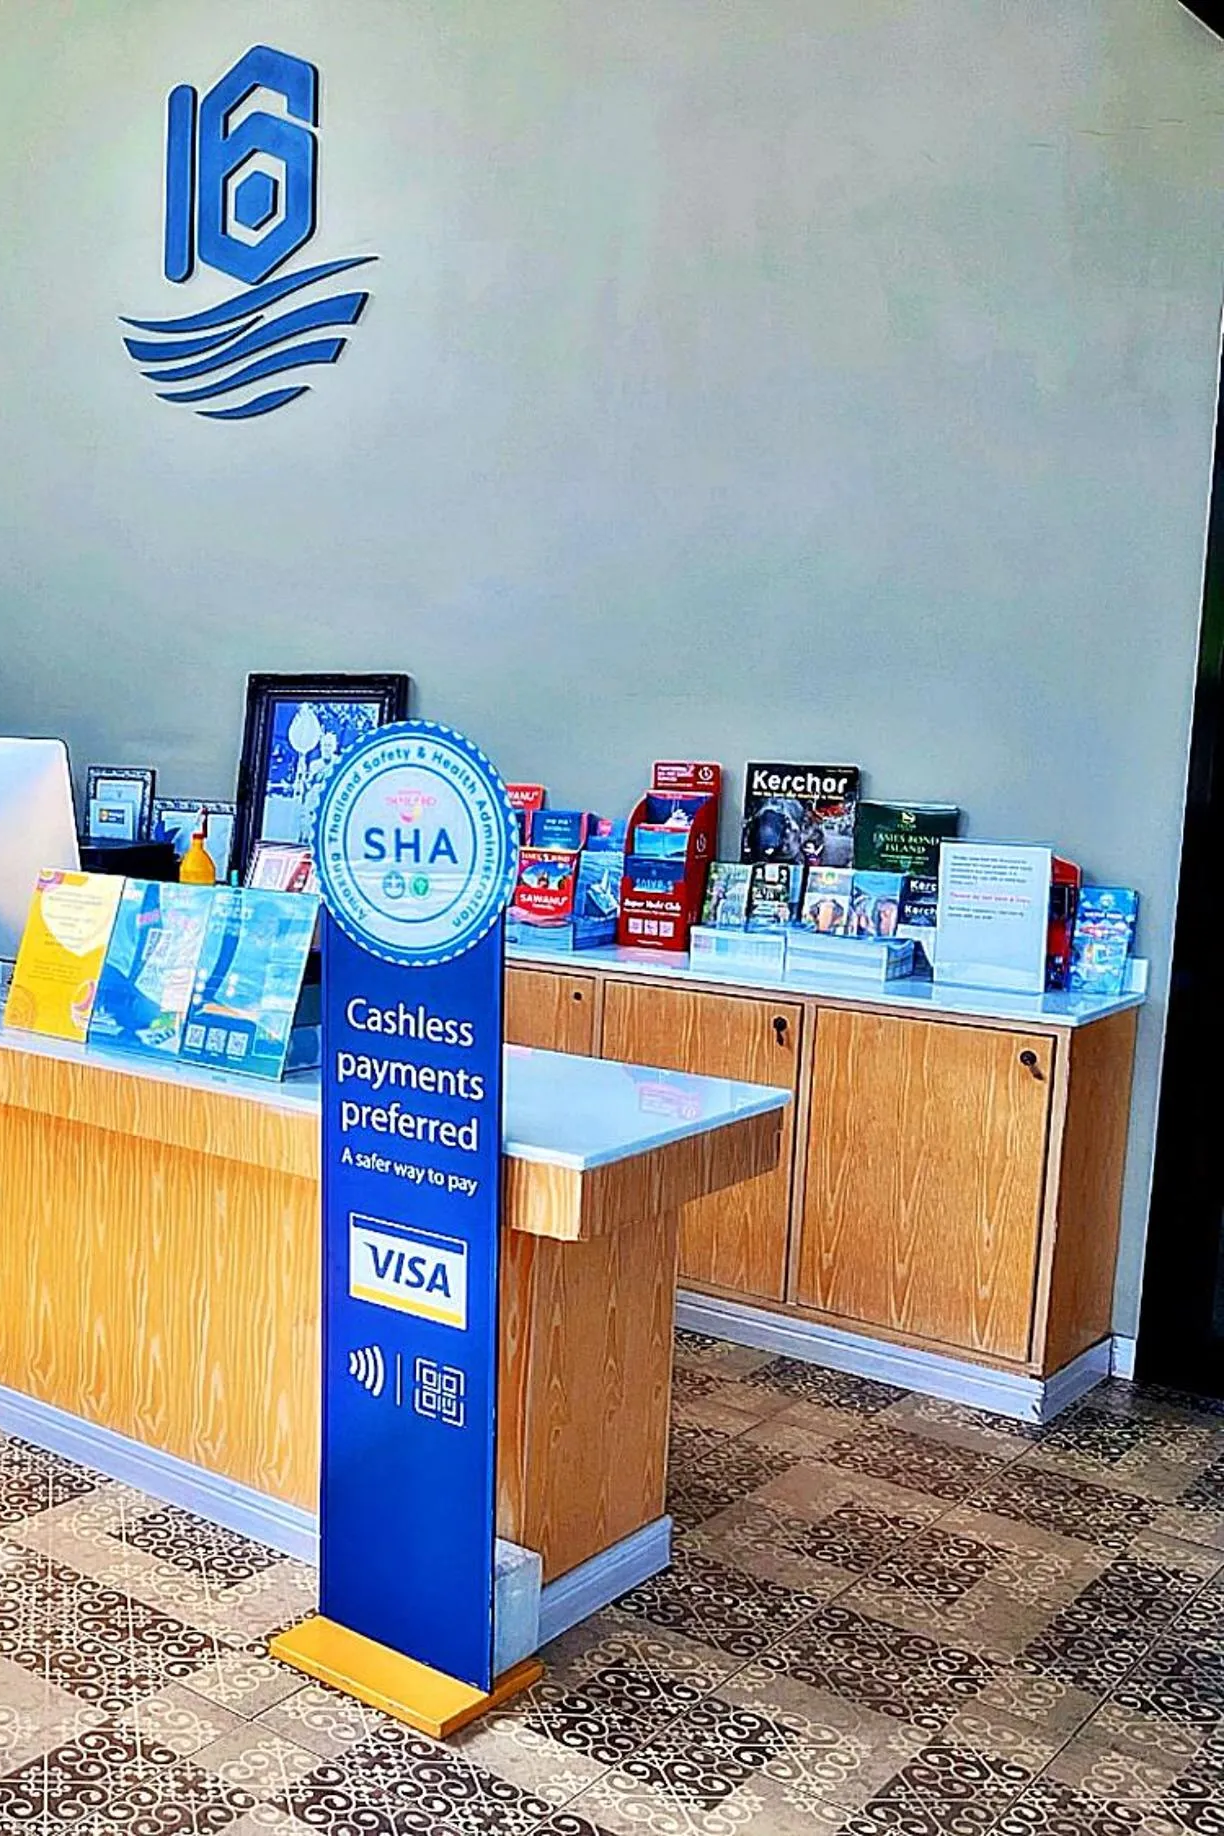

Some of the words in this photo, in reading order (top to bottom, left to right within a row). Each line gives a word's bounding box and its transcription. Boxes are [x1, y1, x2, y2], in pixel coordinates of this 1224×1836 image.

[363, 747, 410, 773] Safety
[417, 746, 426, 760] &
[432, 752, 477, 795] Health
[752, 770, 848, 794] Kerchor
[328, 771, 361, 843] Thailand
[363, 827, 459, 865] SHA
[452, 800, 496, 928] Administration
[885, 843, 926, 854] ISLAND
[330, 852, 367, 921] Amazing
[910, 880, 938, 892] Kerc
[346, 998, 475, 1047] Cashless
[337, 1051, 485, 1101] payments
[341, 1100, 478, 1151] preferred
[341, 1147, 353, 1165] A
[355, 1153, 392, 1173] safer
[393, 1162, 425, 1185] way
[428, 1168, 445, 1186] to
[448, 1176, 478, 1197] pay
[362, 1241, 452, 1299] VISA
